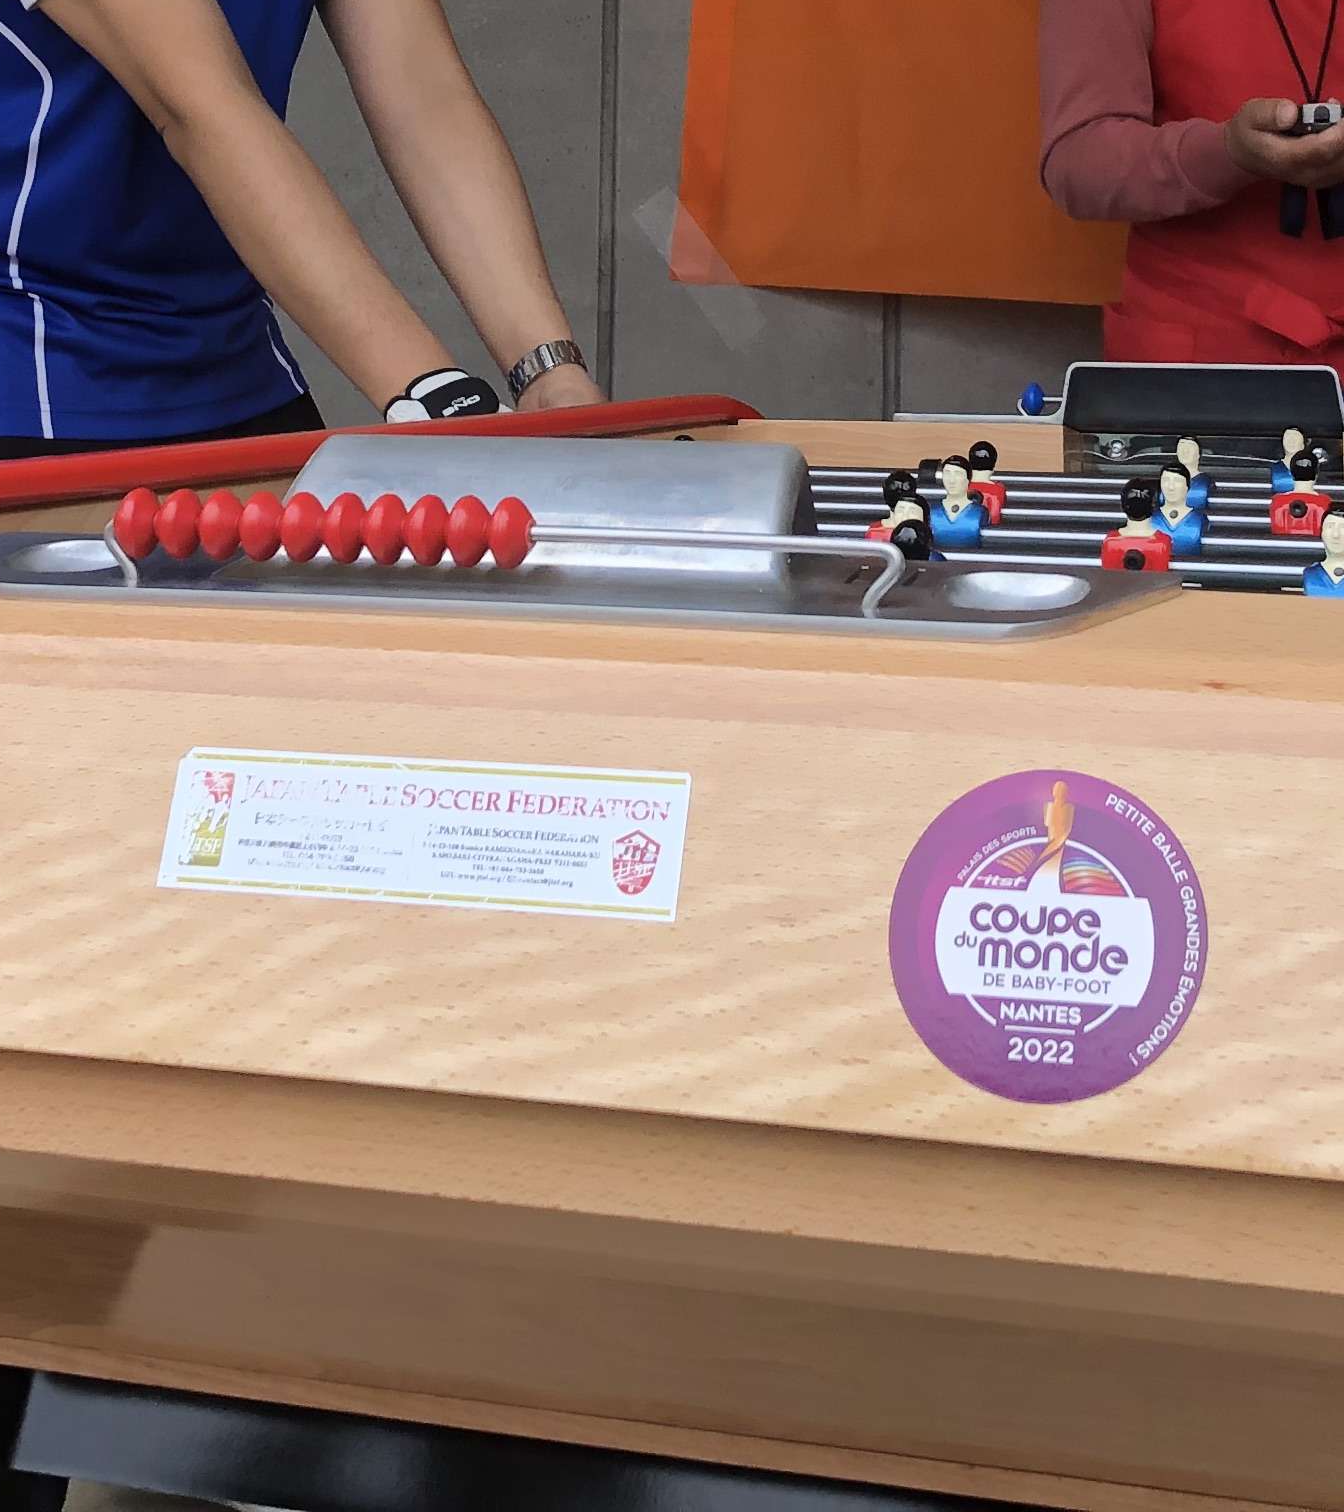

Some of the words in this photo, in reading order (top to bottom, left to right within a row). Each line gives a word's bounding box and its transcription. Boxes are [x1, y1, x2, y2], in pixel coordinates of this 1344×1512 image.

[401, 783, 500, 812] SOCCER
[506, 790, 671, 821] FEDERATION
[1106, 793, 1155, 836] PETITE
[1152, 833, 1189, 885] BALLE
[1180, 886, 1201, 973] GRANDES
[954, 930, 978, 948] du
[978, 935, 1129, 976] monde
[983, 973, 1005, 988] DE
[1011, 975, 1112, 995] BABY-FOOT
[999, 1002, 1082, 1024] NANTES
[1008, 1037, 1075, 1065] 2022
